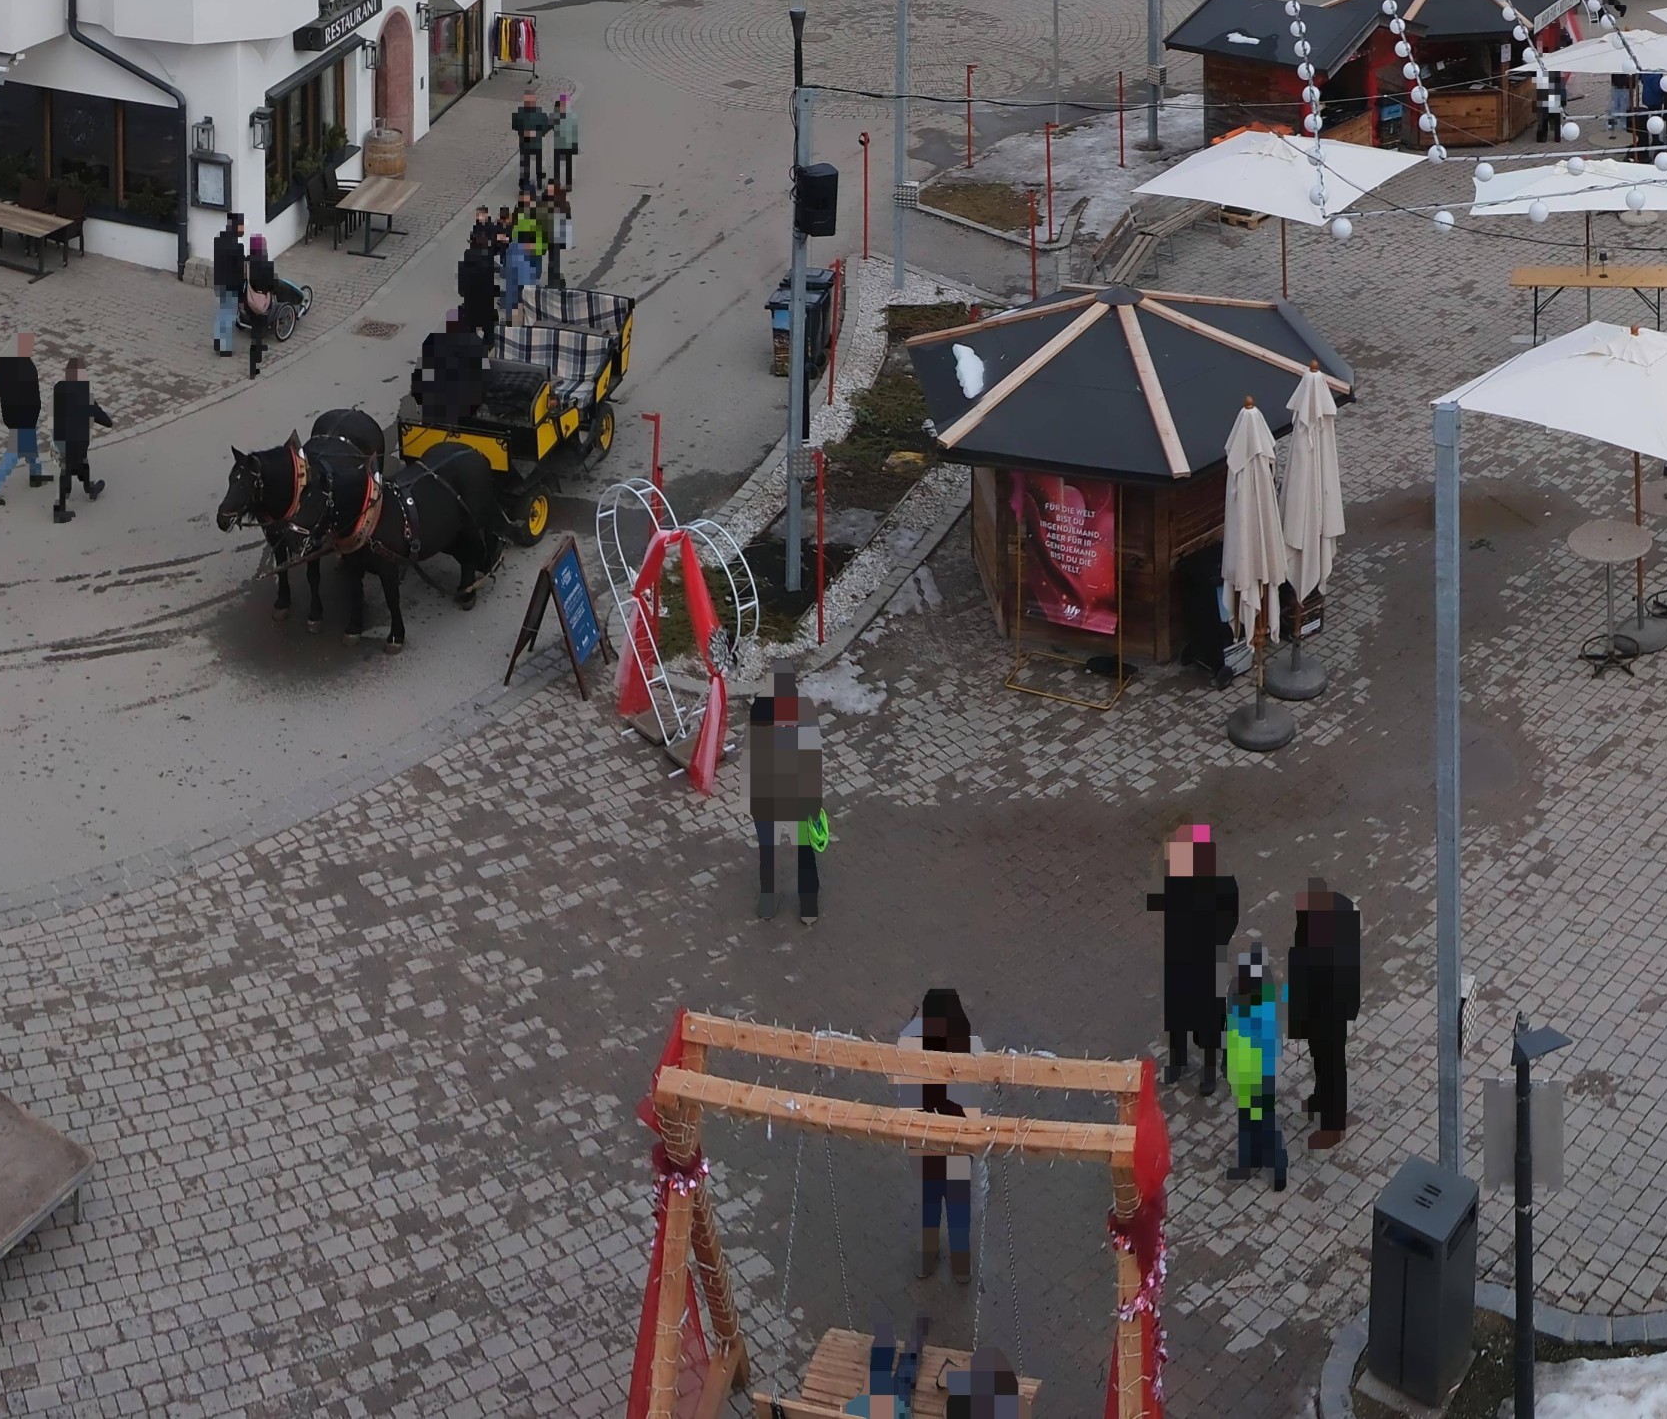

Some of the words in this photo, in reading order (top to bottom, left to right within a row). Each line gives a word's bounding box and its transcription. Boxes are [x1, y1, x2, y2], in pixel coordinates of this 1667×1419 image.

[1045, 502, 1060, 512] FÜR
[1062, 506, 1074, 514] DIE
[1076, 508, 1096, 518] WELT
[1056, 515, 1072, 524] BIST
[1073, 517, 1085, 526] DU
[1040, 520, 1102, 540] IRGENDJEMAND,
[1046, 532, 1066, 542] ABER
[1067, 535, 1082, 546] FÜR
[1083, 539, 1095, 547] IR-
[1045, 540, 1097, 558] GENDJEMAND
[1050, 552, 1065, 562] BIST
[1066, 555, 1077, 564] DU
[1078, 558, 1092, 567] DIE
[1061, 563, 1082, 575] WELT.
[1063, 604, 1081, 620] My
